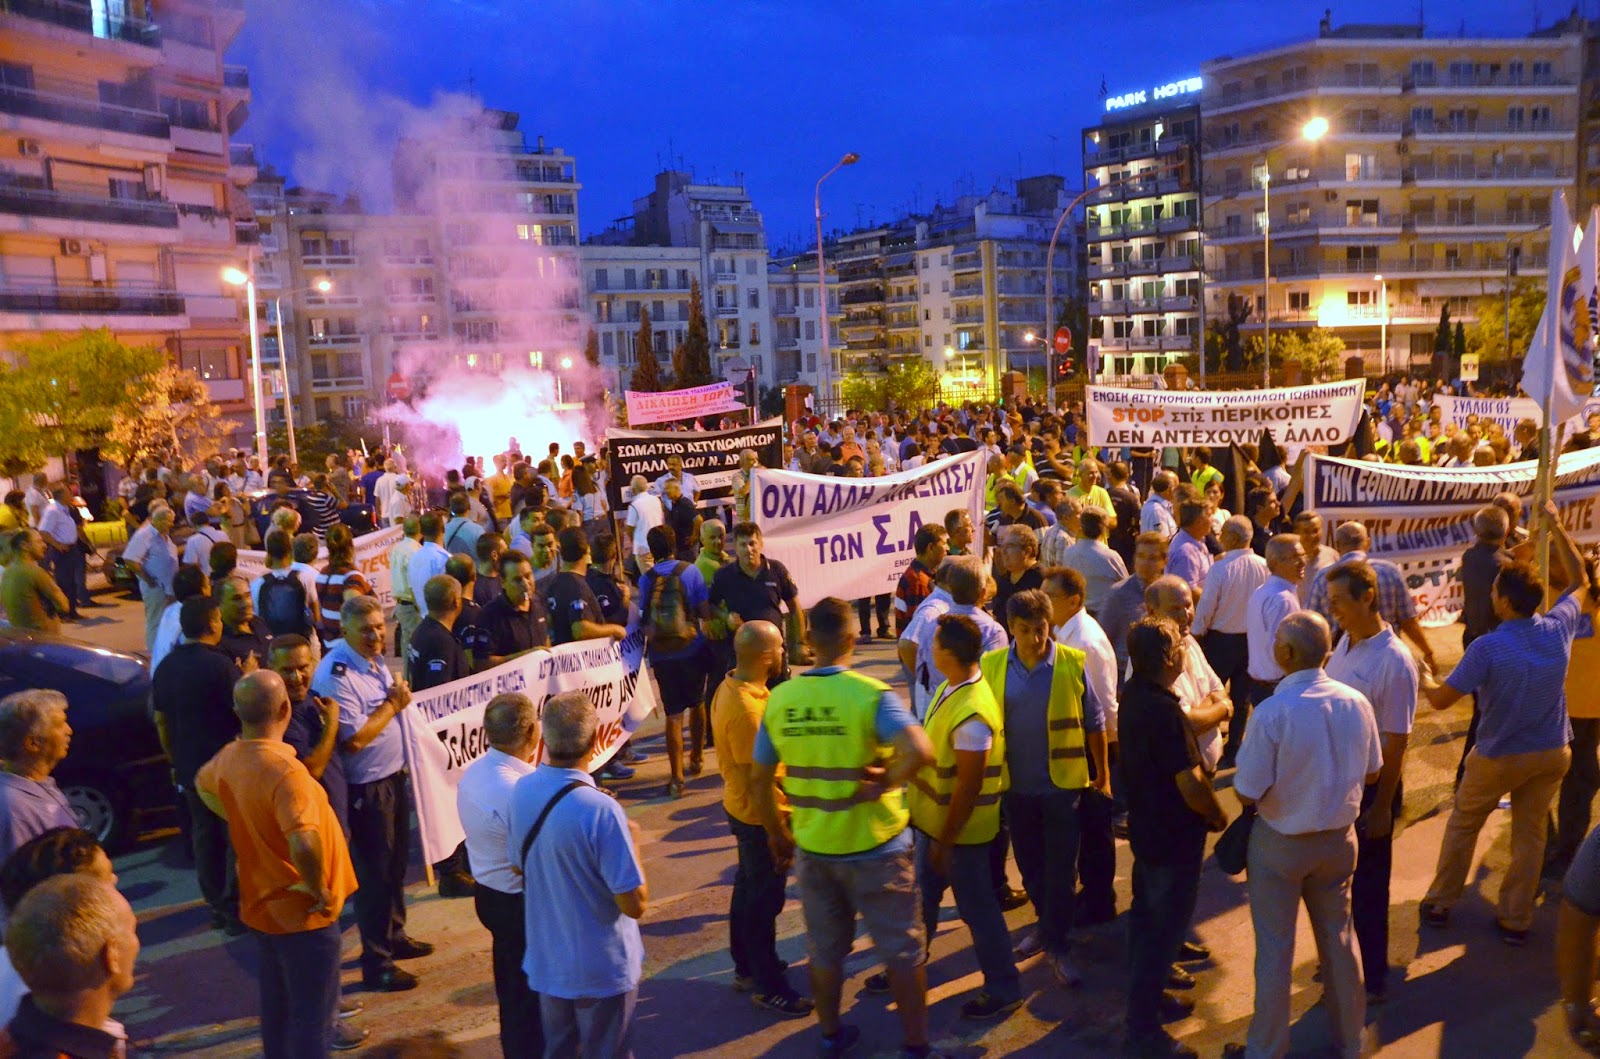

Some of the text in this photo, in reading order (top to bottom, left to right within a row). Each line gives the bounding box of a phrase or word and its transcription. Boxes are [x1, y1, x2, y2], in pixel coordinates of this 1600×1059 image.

[1106, 90, 1146, 111] PARK
[637, 389, 732, 410] ΔΙΚΑΙΩΣΗ ΤΩΡΑ
[1093, 385, 1357, 404] ΕΝΩΣΗ ΑΣΤΥΝΟΜΙΚΩΝ ΥΠΑΛΛΗΛΩΝ ΙΩΑΝΝΙΝΩΝ
[1112, 407, 1165, 422] STOP
[1212, 404, 1332, 422] ΠΕΡΙΚΟΠΕΣ
[1452, 399, 1511, 415] ΣΥΛΛΟΓΟΣ
[617, 432, 776, 458] ΣΩΜΑΤΕΙΟ ΑΣΤΥΝΟΜΙΚΩΝ
[1106, 430, 1144, 443] ΔΕΝ
[1284, 427, 1340, 442] ΑΛΛΟ
[622, 453, 741, 475] ΥΠΑΛΛΛΩΝ Ν. ΔΡ
[1321, 464, 1355, 503] ΤΗΝ
[1356, 466, 1420, 502] ΕΘΝΙΚΗ
[762, 483, 805, 518] ΟΧΙ
[812, 484, 876, 516] ΑΛΛΗ
[814, 510, 925, 565] ΤΩΝ Σ.Α
[887, 572, 904, 582] ΑΣΤ
[416, 678, 493, 723] ΣΥΝΔΙΚΑΛΙΣΤΙΚΗ
